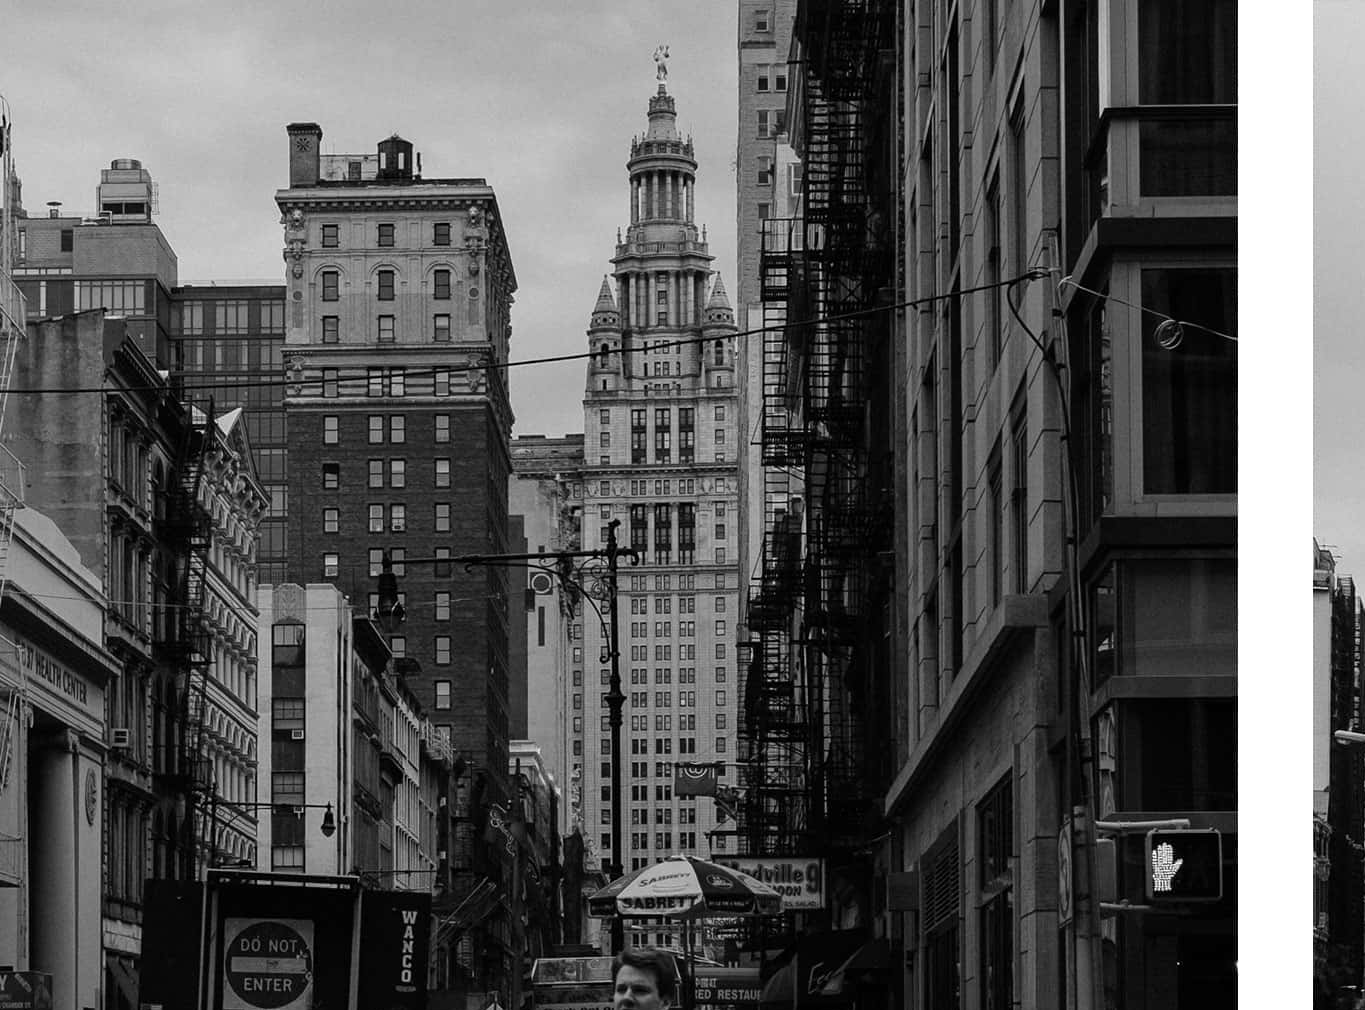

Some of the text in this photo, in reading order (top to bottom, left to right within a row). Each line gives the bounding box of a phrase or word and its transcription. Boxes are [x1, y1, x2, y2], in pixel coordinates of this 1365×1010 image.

[35, 648, 61, 689] HEALTH
[63, 671, 87, 706] CENTER
[622, 896, 697, 909] SABRETT
[240, 937, 298, 953] DO NOT
[401, 910, 418, 983] WANCO
[243, 977, 292, 992] ENTER
